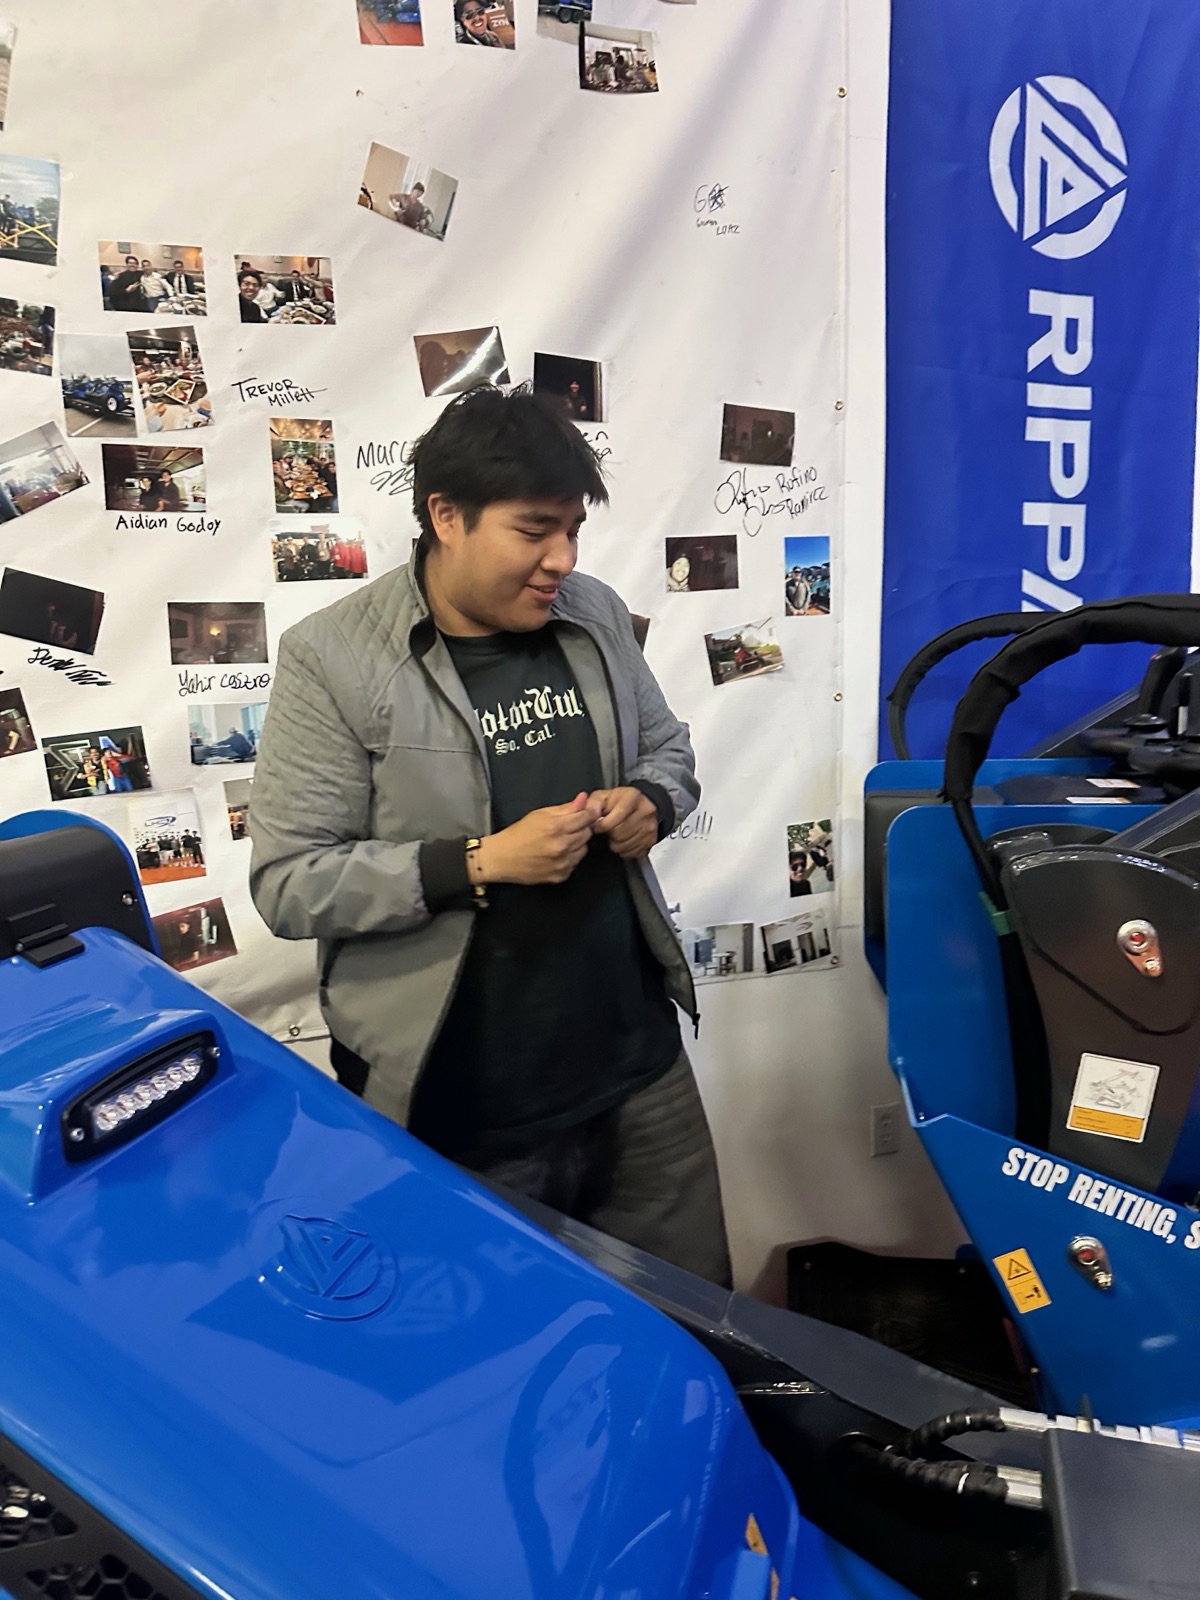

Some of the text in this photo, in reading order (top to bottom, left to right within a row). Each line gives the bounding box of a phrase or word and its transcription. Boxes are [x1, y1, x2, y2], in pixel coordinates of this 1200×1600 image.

[230, 376, 299, 402] TREVOR
[115, 513, 221, 536] Aidian Godoy
[473, 685, 585, 740] otorCul
[1001, 1147, 1070, 1192] STOP
[1067, 1173, 1177, 1244] RENTING,
